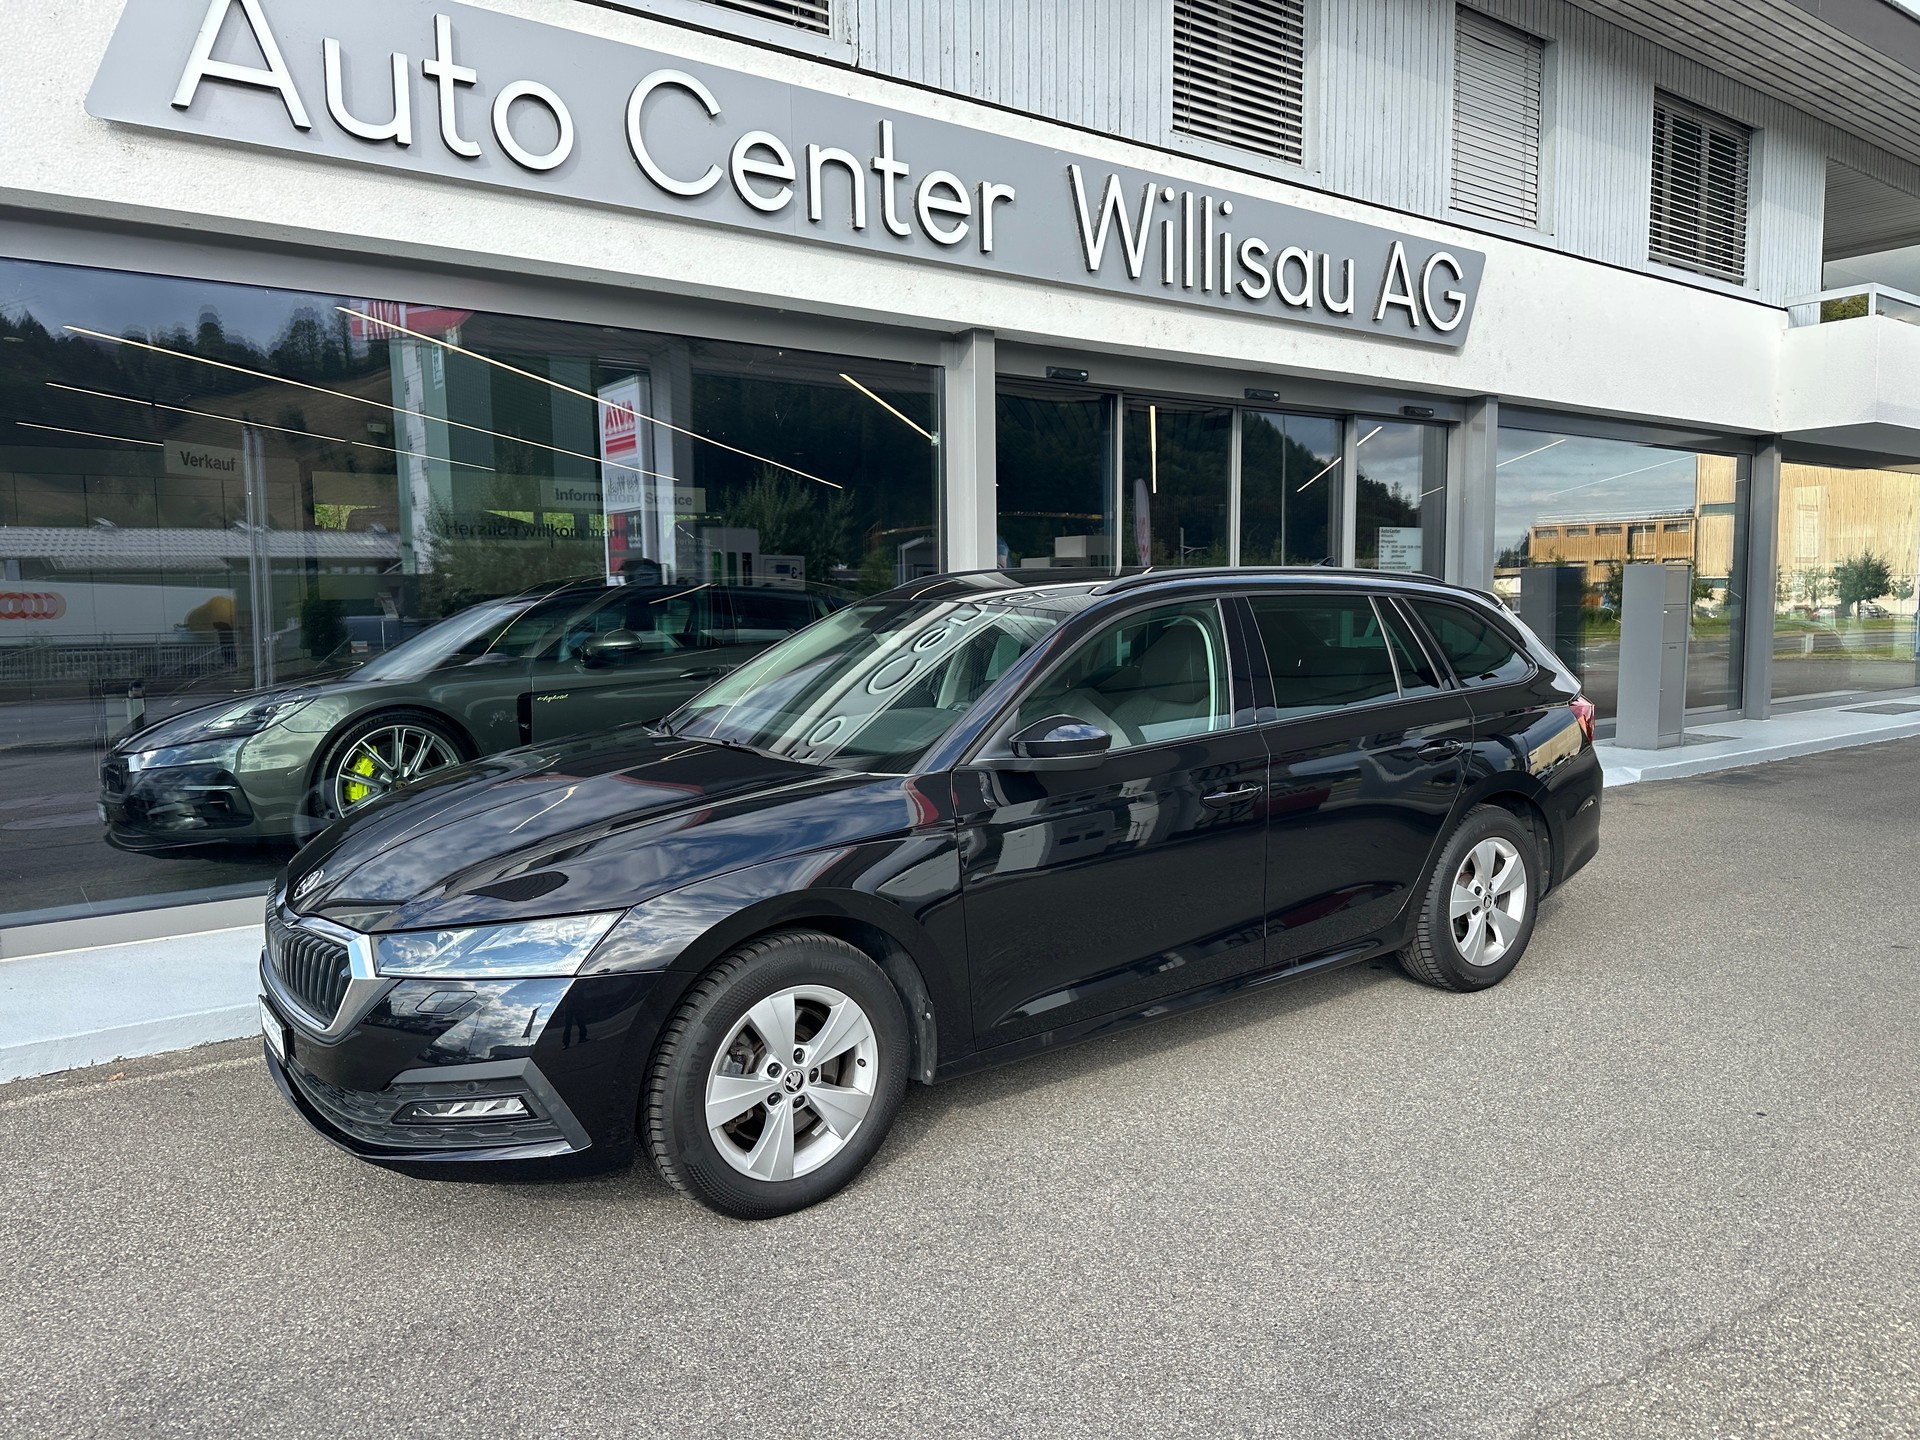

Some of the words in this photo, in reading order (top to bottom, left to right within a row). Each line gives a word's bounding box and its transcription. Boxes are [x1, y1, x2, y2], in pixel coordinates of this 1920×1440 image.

[171, 0, 574, 171] Auto
[624, 68, 1015, 254] Center
[1066, 163, 1355, 315] Willisau
[1372, 240, 1467, 333] AG
[180, 451, 236, 472] Verkauf
[555, 487, 635, 504] Information
[644, 492, 693, 506] Service
